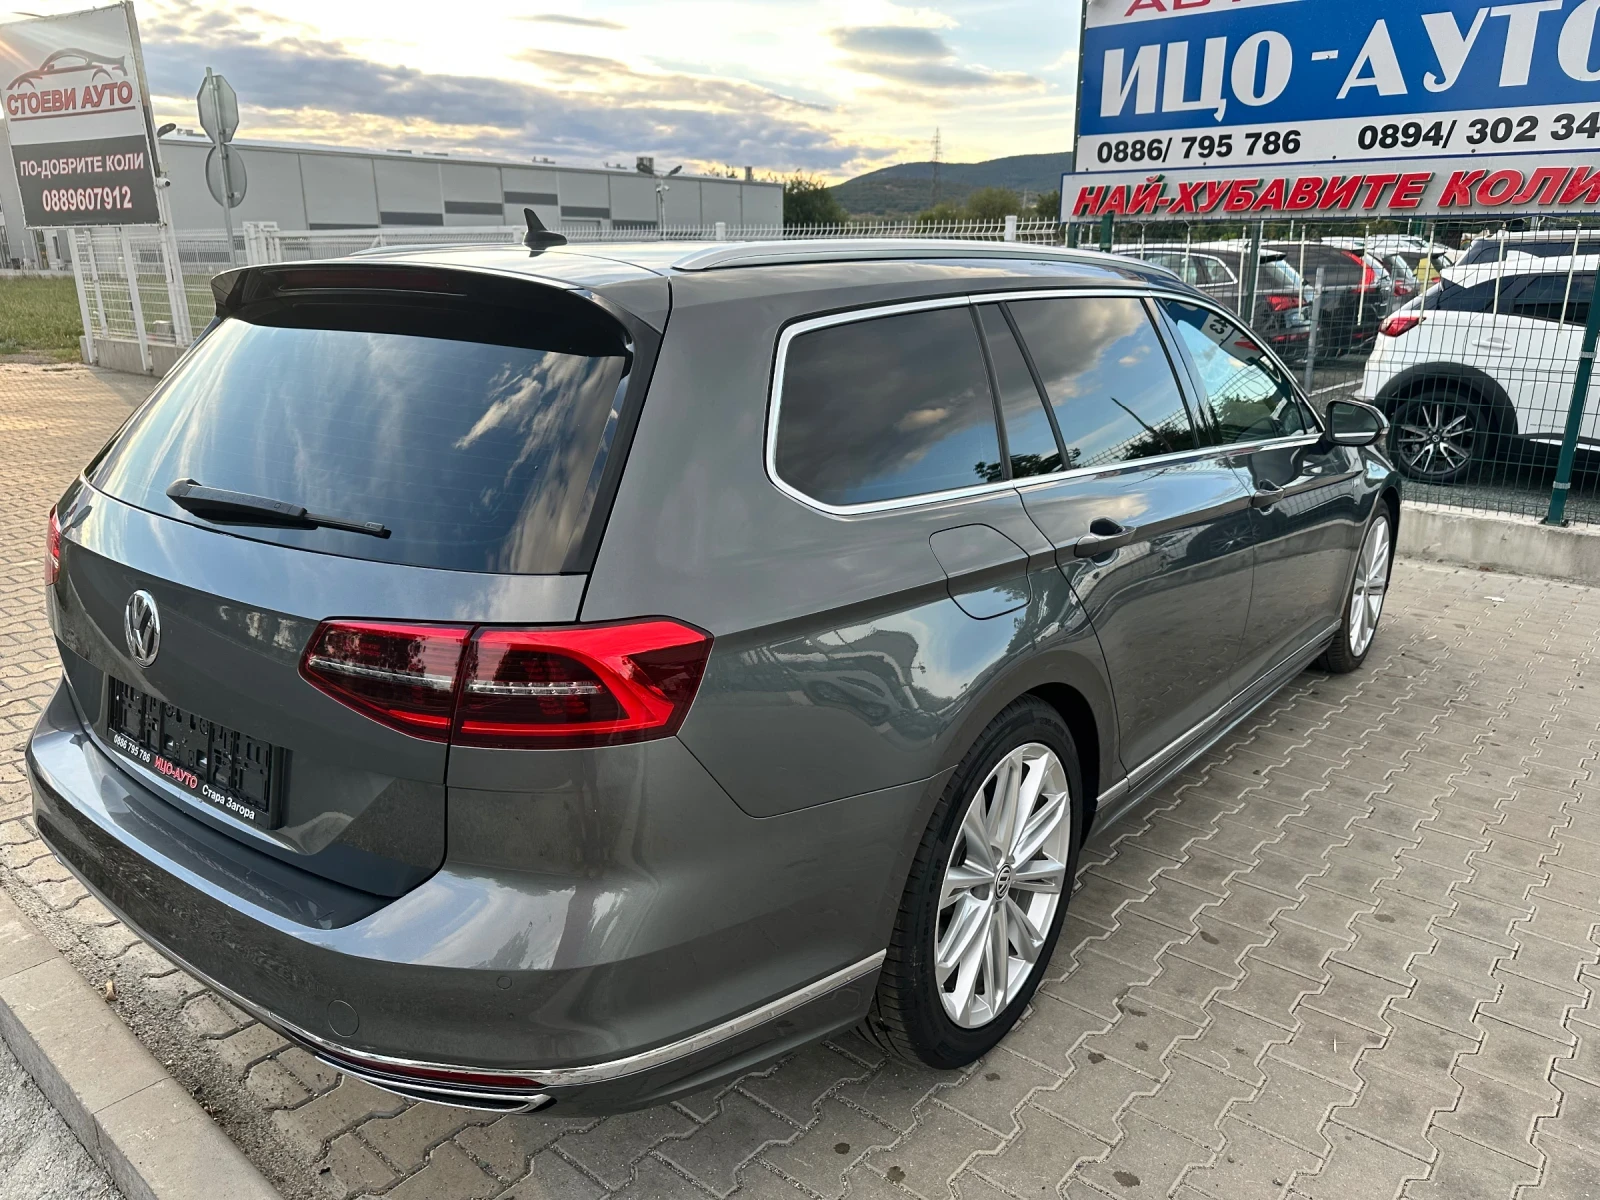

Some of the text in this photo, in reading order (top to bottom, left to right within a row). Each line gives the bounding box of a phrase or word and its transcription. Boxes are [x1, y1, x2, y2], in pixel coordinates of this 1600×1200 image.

[6, 80, 133, 116] СТОЕВИ АУТО
[1181, 133, 1233, 159] 795
[1245, 130, 1302, 156] 786
[1466, 115, 1539, 145] 302
[20, 152, 144, 179] ПО-ДОБРИТЕ КОЛИ
[42, 185, 132, 212] 0889607912
[1072, 172, 1434, 217] НАЙ-ХУБАВИТЕ
[154, 755, 198, 789] ИЦО-АУТО
[202, 784, 225, 805] Стара
[226, 797, 256, 820] Загора
